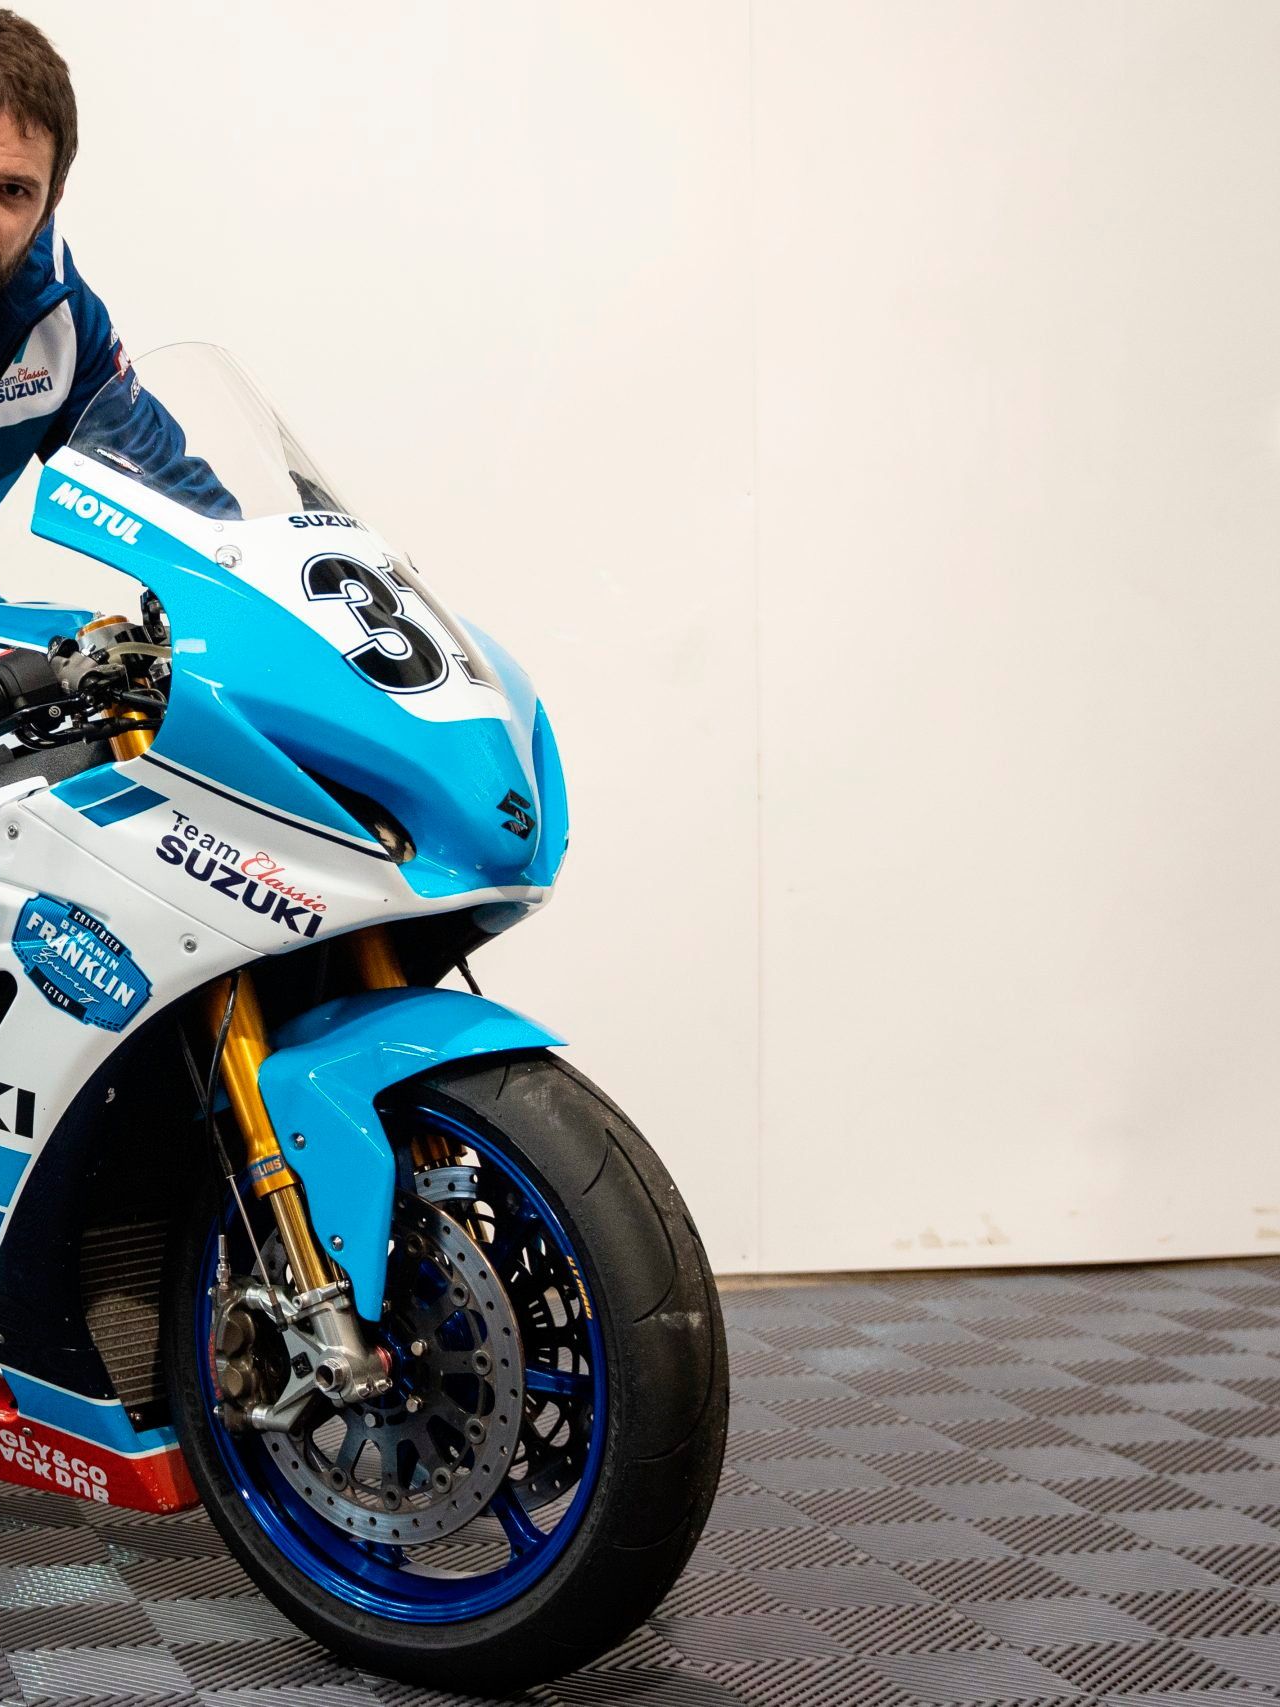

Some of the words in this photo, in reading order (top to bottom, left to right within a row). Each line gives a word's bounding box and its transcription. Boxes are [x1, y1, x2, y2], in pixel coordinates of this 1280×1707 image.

[48, 481, 144, 546] MOTUL
[155, 834, 324, 939] SUZUKI
[172, 809, 241, 865] Team
[240, 851, 328, 913] Classic
[26, 911, 136, 1008] FRANKLIN
[60, 919, 120, 971] BENJAMIN
[73, 910, 102, 934] CRAFT
[98, 930, 121, 953] BEER
[42, 981, 70, 1008] ECTON
